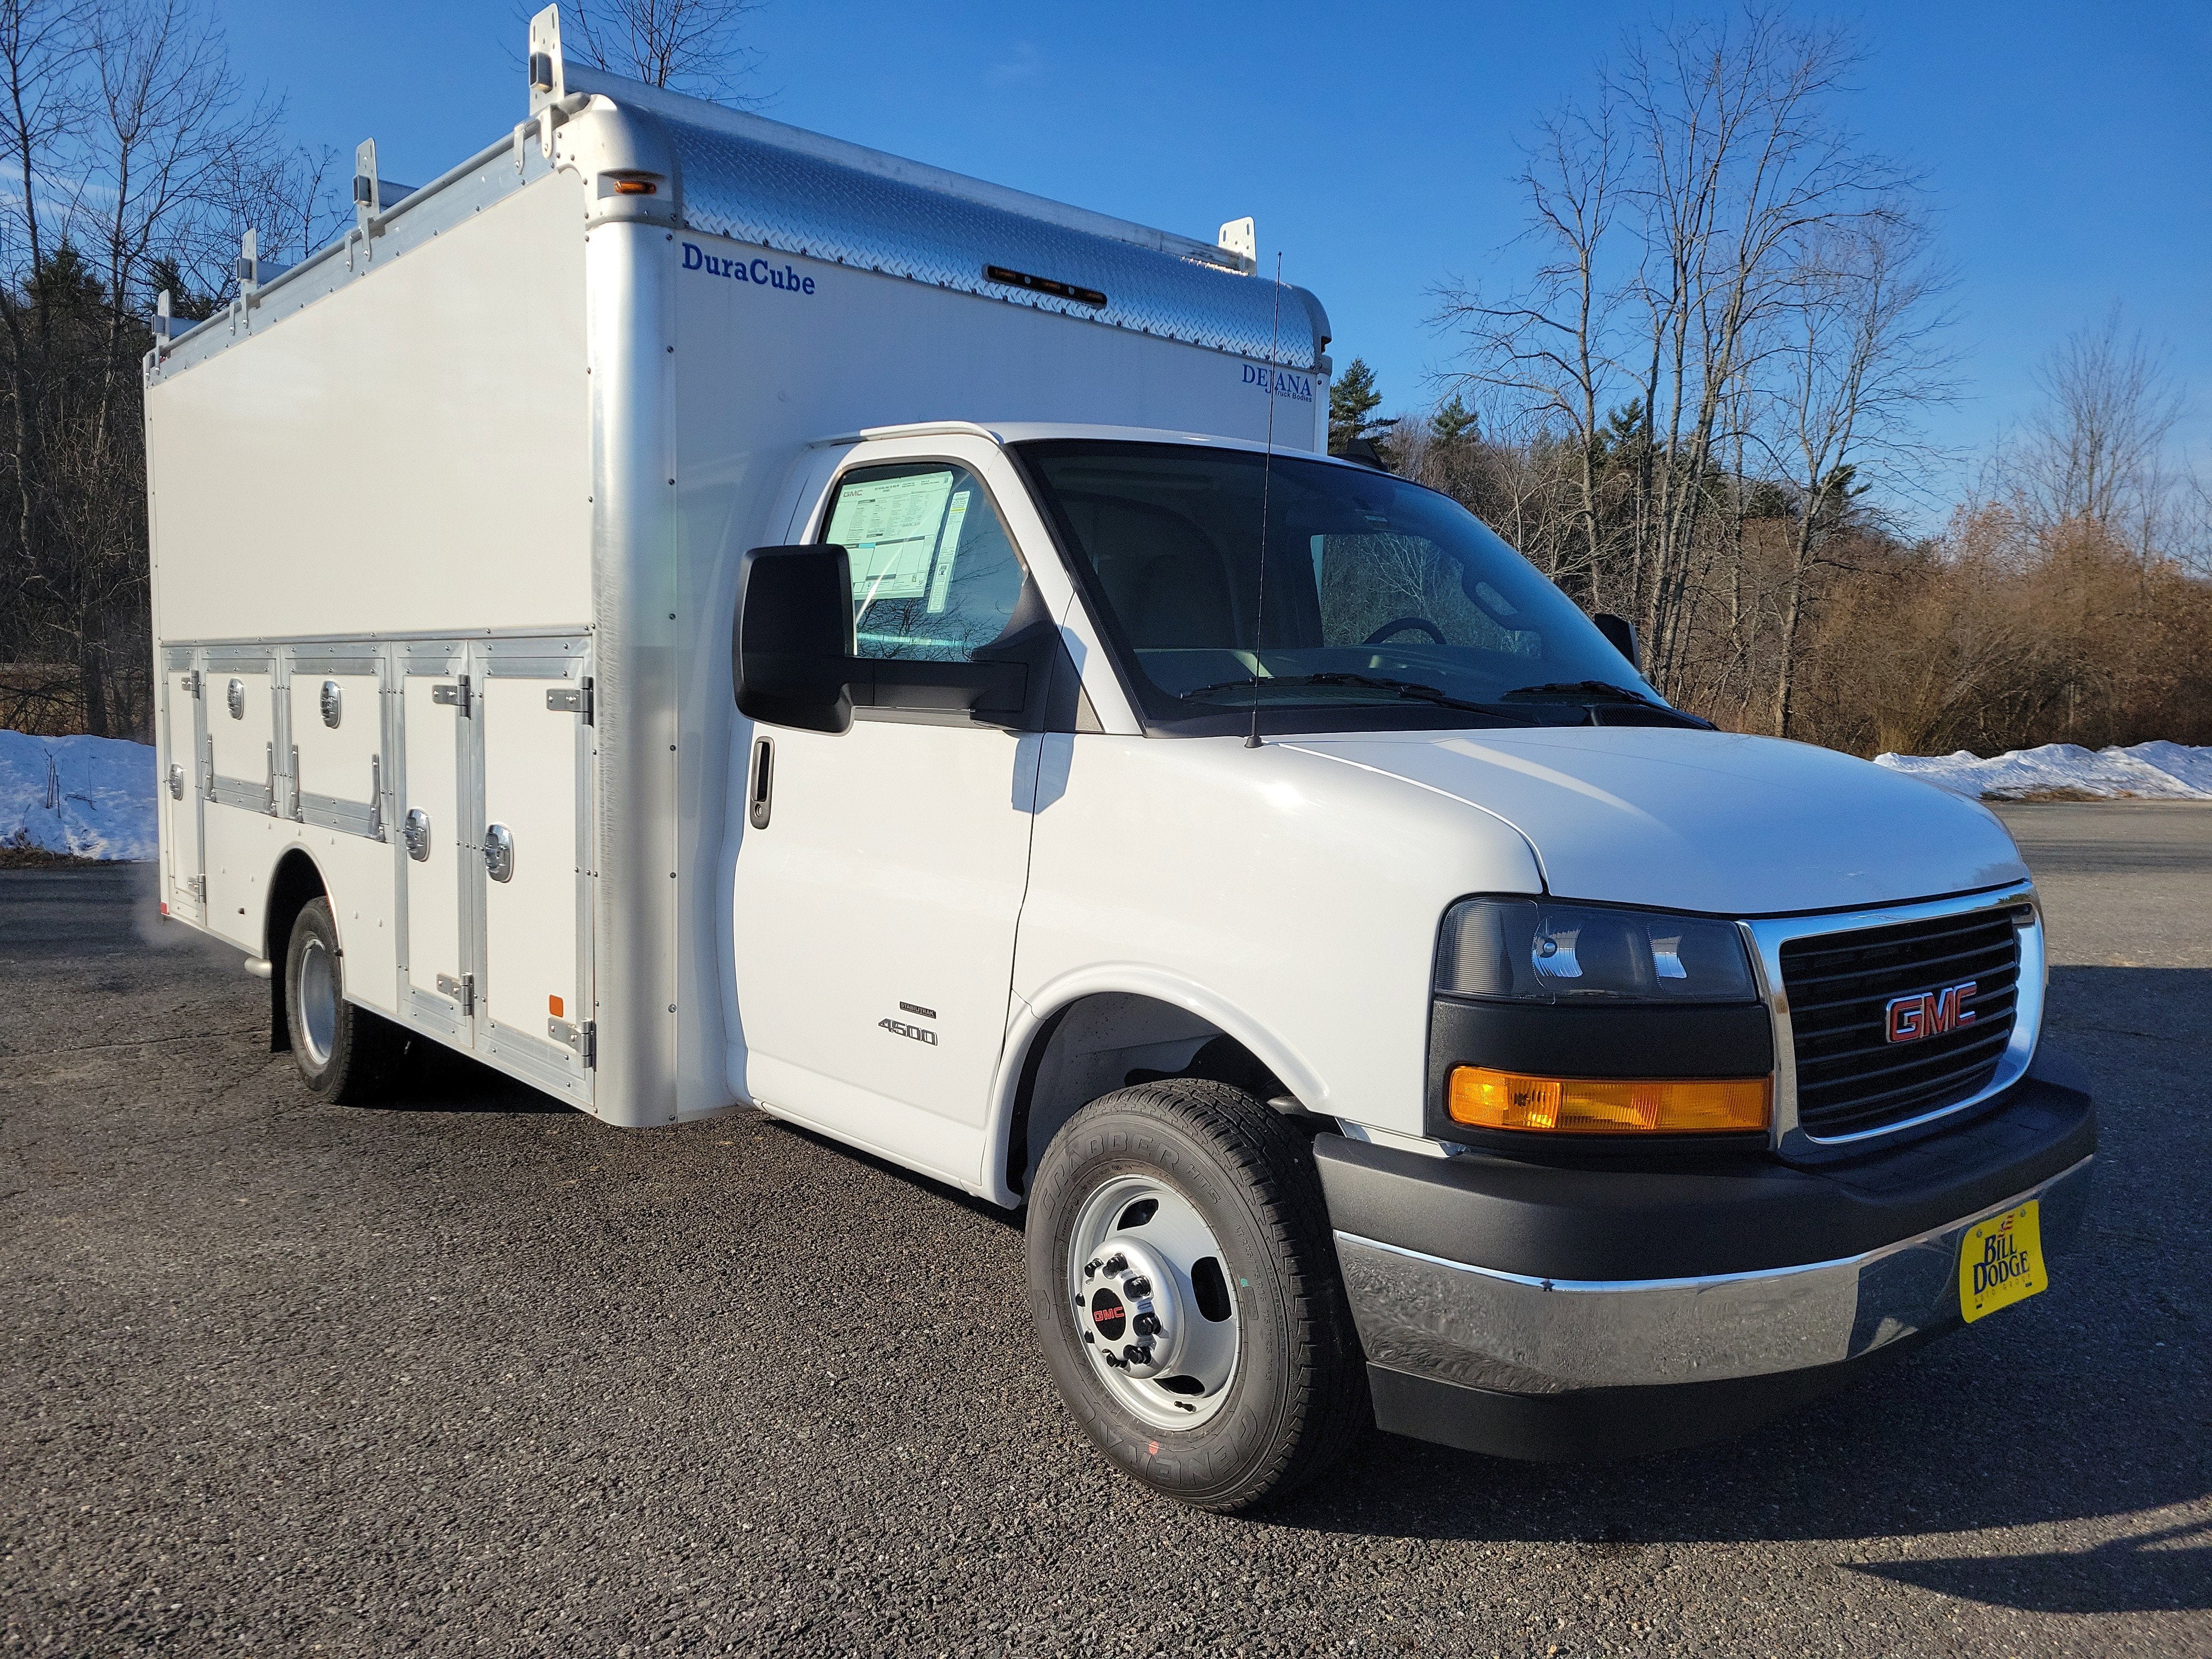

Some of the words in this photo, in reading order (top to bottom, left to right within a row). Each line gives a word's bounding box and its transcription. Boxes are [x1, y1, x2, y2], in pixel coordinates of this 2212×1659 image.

[682, 242, 815, 295] DuraCube
[1242, 364, 1312, 397] DEJANA
[1274, 389, 1291, 398] Truck
[1292, 392, 1312, 403] Bodies
[843, 489, 863, 498] GMC
[900, 1002, 935, 1017] STABILITRAK
[1886, 981, 1977, 1043] GMC
[878, 1018, 938, 1046] 4500
[1984, 1233, 2017, 1266] BILL
[1973, 1250, 2030, 1296] DODGE
[1093, 1306, 1125, 1322] GMC
